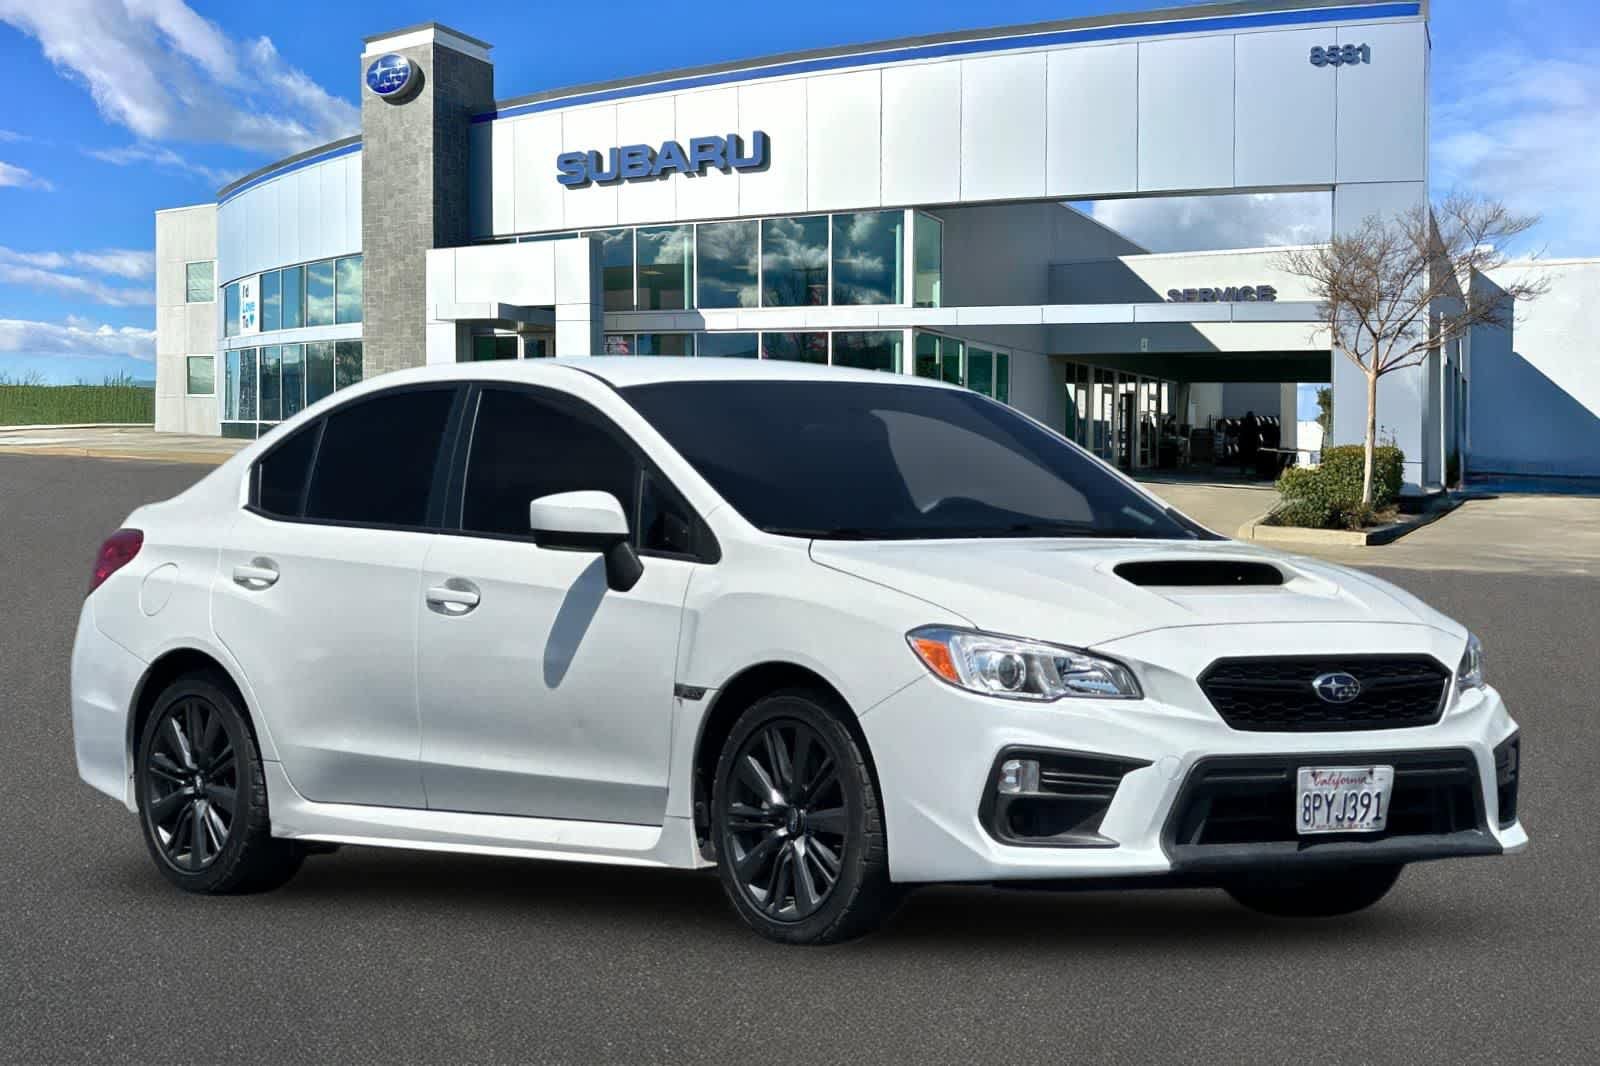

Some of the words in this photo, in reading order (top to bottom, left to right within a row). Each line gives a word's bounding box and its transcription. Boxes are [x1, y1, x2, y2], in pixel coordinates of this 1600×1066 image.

[556, 130, 771, 190] SUBARU
[1166, 284, 1277, 303] SERVICE
[1303, 792, 1382, 825] 8PYJ391
